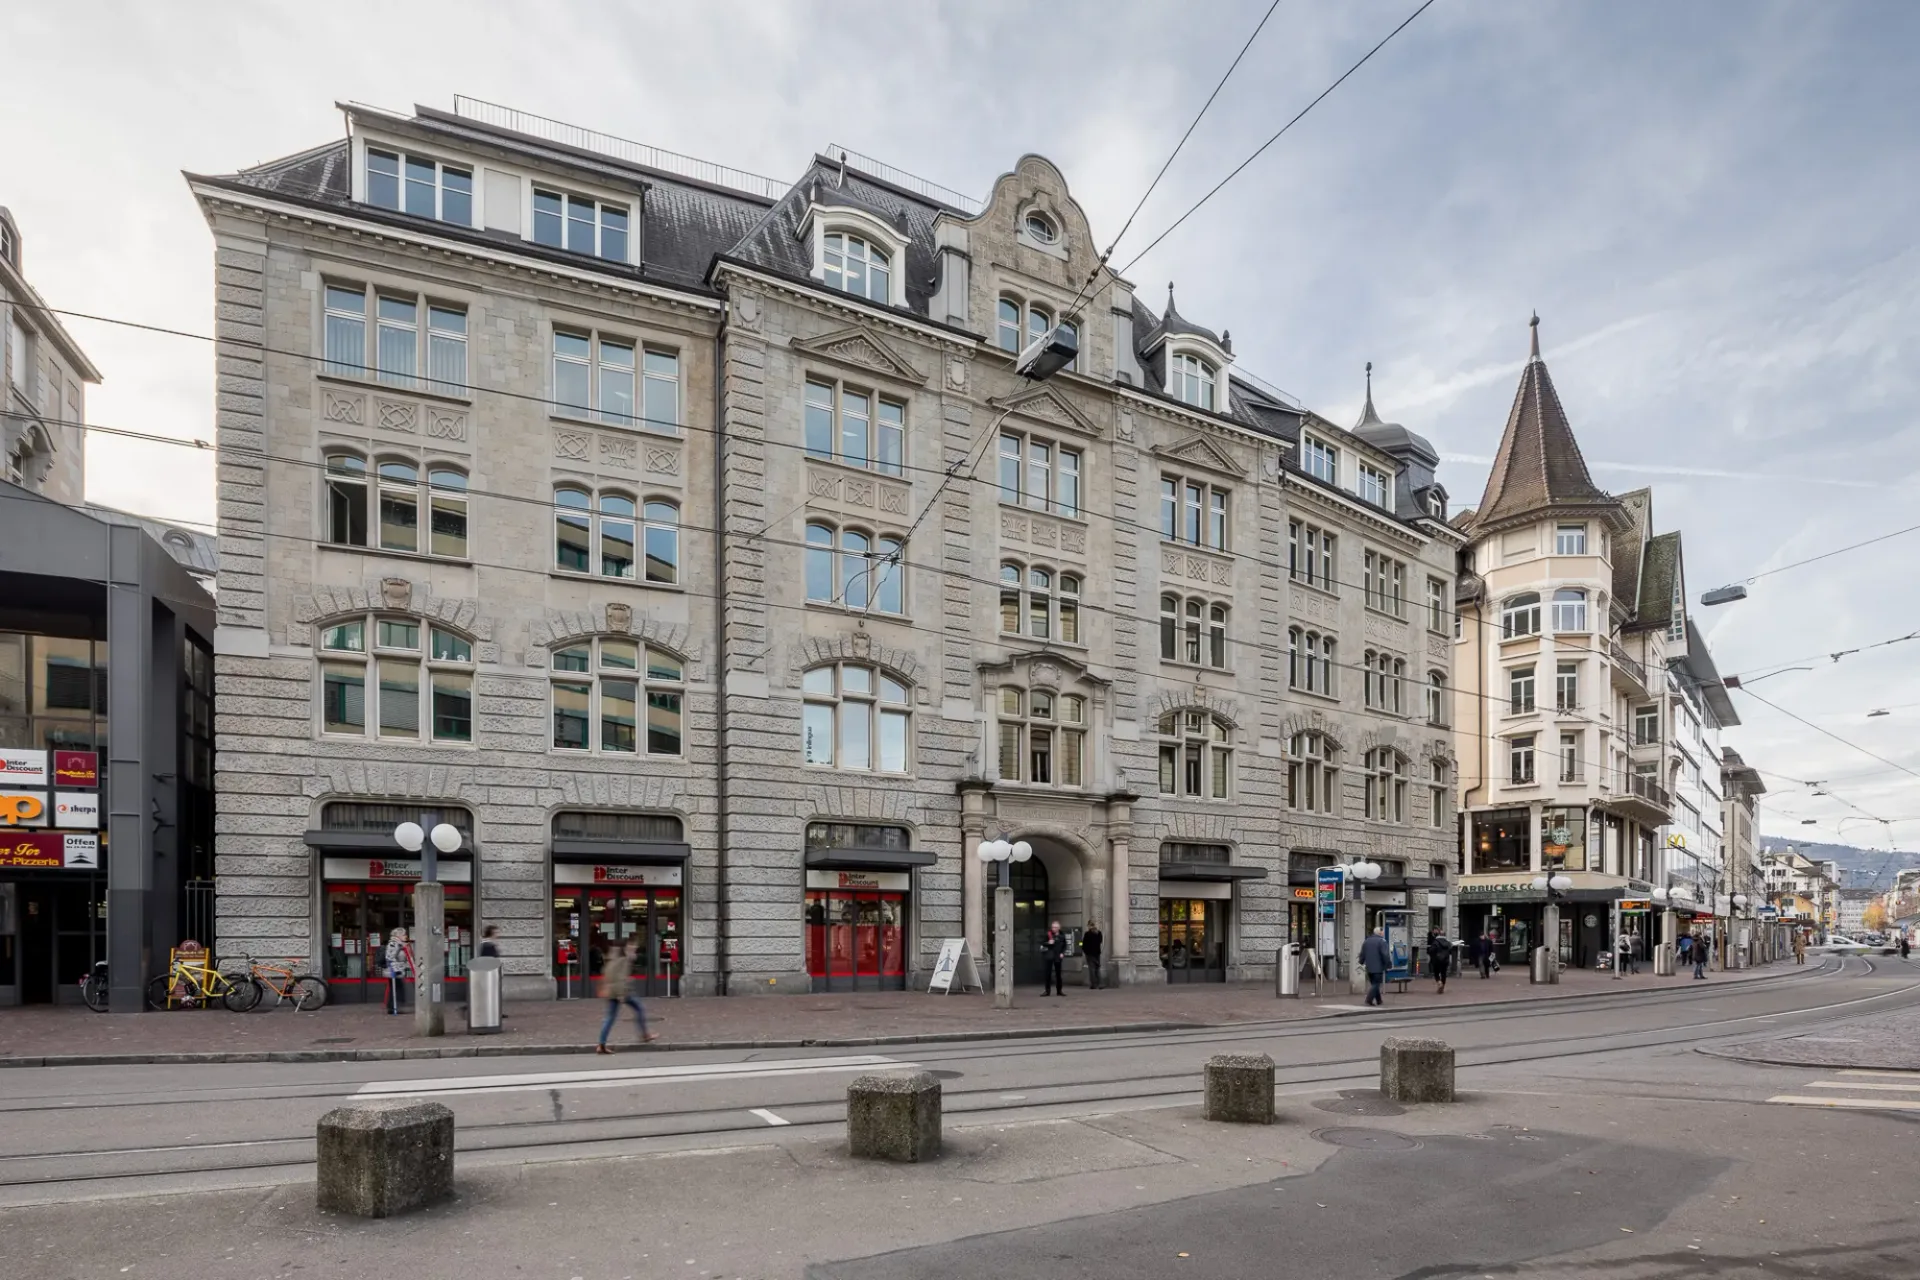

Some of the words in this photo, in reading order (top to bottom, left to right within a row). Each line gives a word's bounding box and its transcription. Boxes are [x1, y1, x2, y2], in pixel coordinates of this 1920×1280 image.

[70, 803, 97, 814] sherpa
[66, 838, 95, 846] Offen
[14, 843, 40, 856] Tor
[0, 857, 60, 866] r-Pizzeria
[384, 861, 408, 869] Inter
[384, 868, 422, 876] Discoun
[1458, 883, 1517, 894] ARBUCKS
